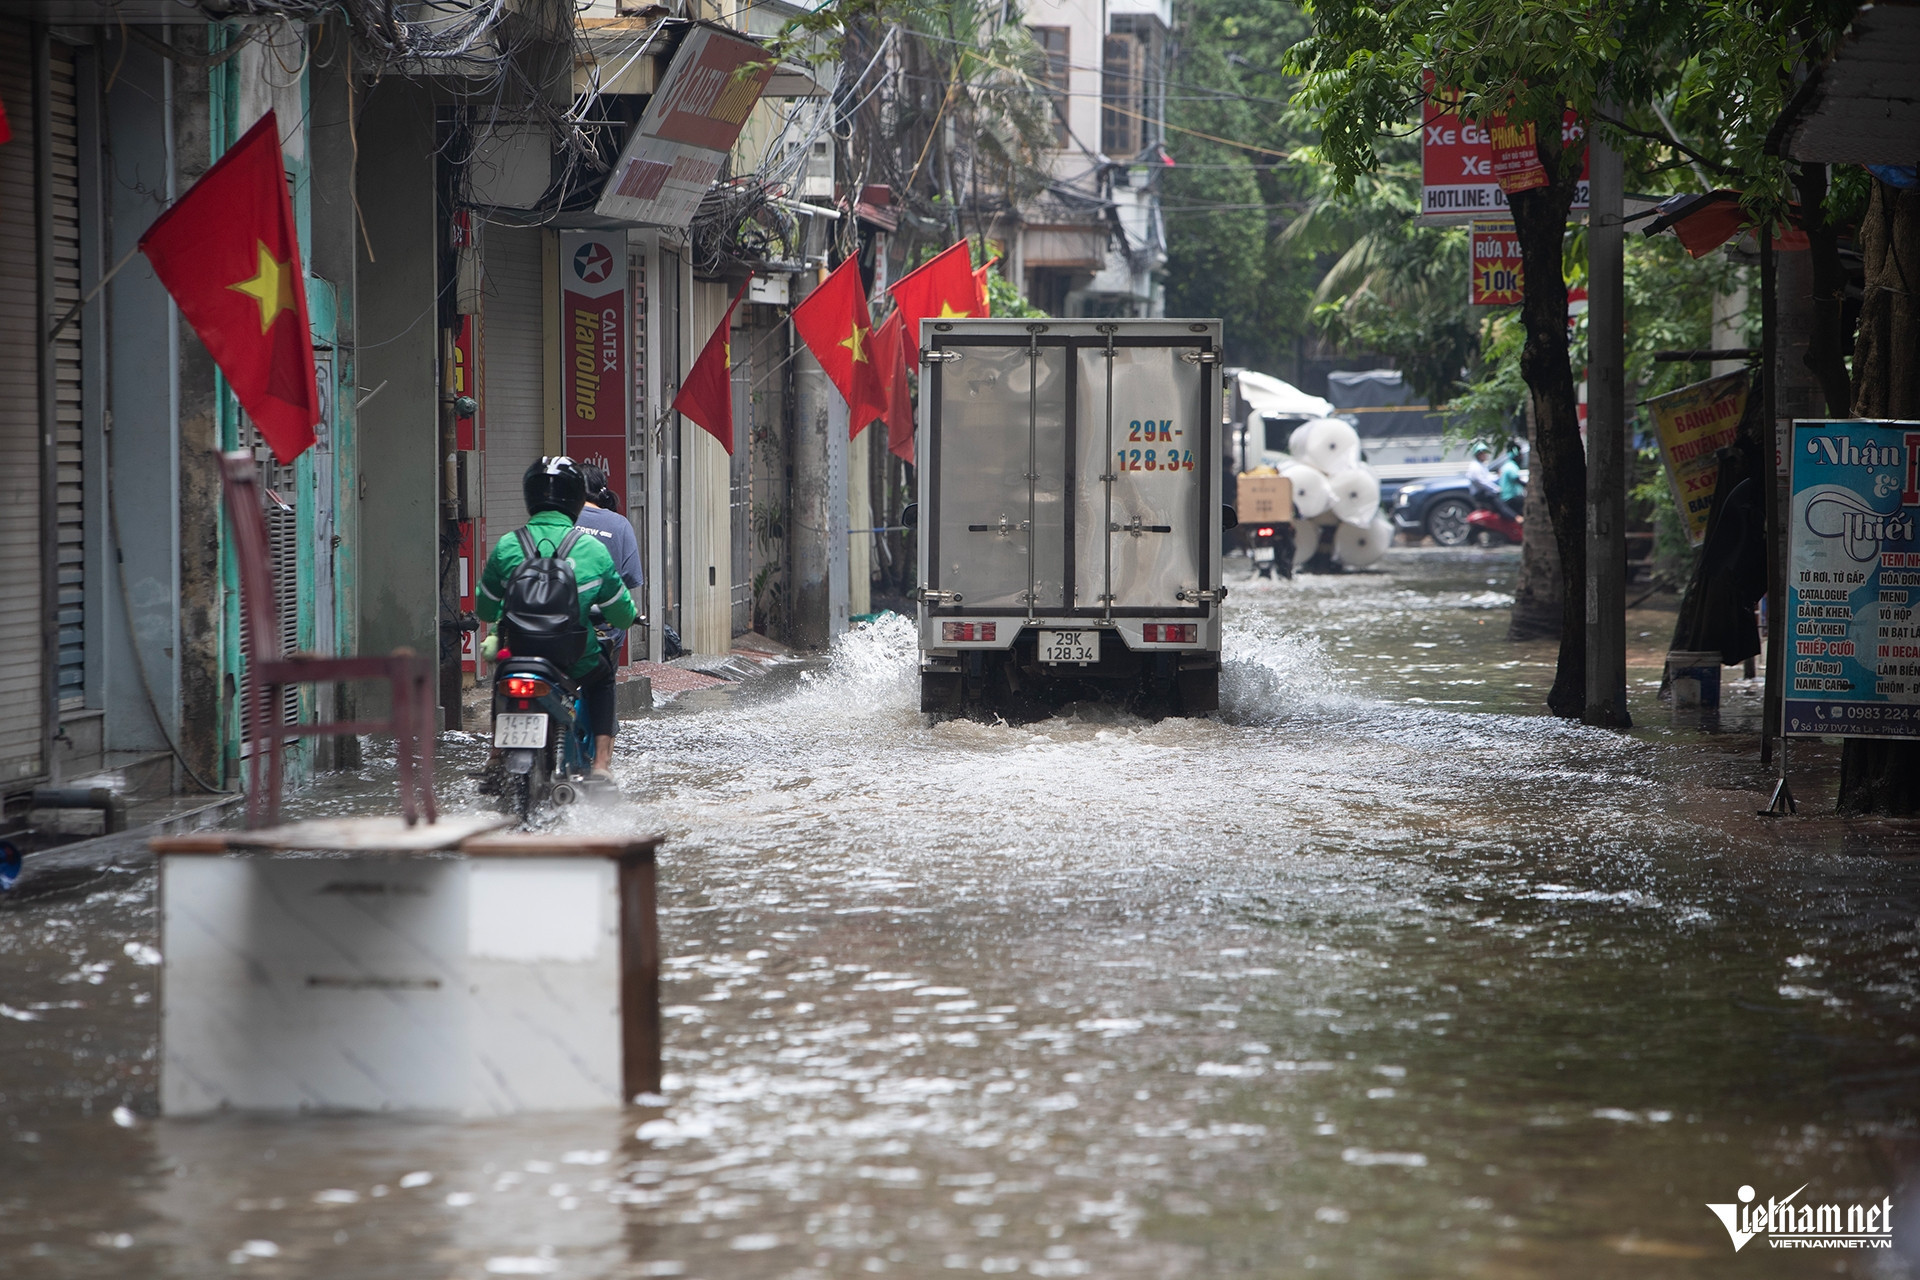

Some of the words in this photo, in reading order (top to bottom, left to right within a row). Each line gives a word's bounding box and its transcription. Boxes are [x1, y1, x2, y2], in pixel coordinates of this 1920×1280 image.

[677, 66, 727, 117] CALTEX
[1426, 126, 1456, 146] Xe
[1428, 189, 1490, 208] HOTLINE:
[1476, 236, 1503, 258] RỬA
[602, 308, 616, 372] CALTEX
[575, 308, 600, 421] Havoline
[1129, 420, 1183, 442] 29K-
[1117, 449, 1195, 471] 128.34
[1807, 436, 1901, 474] Nhận
[1805, 490, 1914, 562] Thiết
[1881, 554, 1904, 566] TEM
[1800, 569, 1811, 582] TỜ
[1813, 572, 1831, 584] RƠI,
[1833, 570, 1845, 583] TỜ
[1847, 568, 1866, 584] GẤP,
[1881, 571, 1899, 585] HÓA
[1799, 589, 1848, 600] CATALOGUE
[1880, 591, 1907, 602] MENU
[1799, 602, 1823, 617] BẰNG
[1825, 607, 1852, 619] KHEN,
[1894, 607, 1912, 622] HỘP
[1798, 619, 1818, 635] GIẤY
[1820, 624, 1845, 635] KHEN
[1879, 627, 1889, 637] IN
[1891, 627, 1908, 640] BẠT
[1056, 633, 1082, 646] 29K
[1797, 637, 1827, 655] THIẾP
[1829, 640, 1854, 655] CƯỚI
[1047, 647, 1093, 660] 128.34
[1878, 646, 1889, 657] IN
[1892, 646, 1920, 658] DECA
[1797, 660, 1813, 674] (lấy
[1815, 662, 1842, 674] Ngay)
[1877, 662, 1897, 675] LÀM
[1796, 679, 1822, 690] NAME
[1877, 681, 1904, 693] NHÔM
[1847, 706, 1880, 719] 0983
[1884, 707, 1909, 720] 224
[1800, 721, 1812, 731] Số
[1814, 723, 1828, 732] 197
[1882, 725, 1904, 734] Phúc
